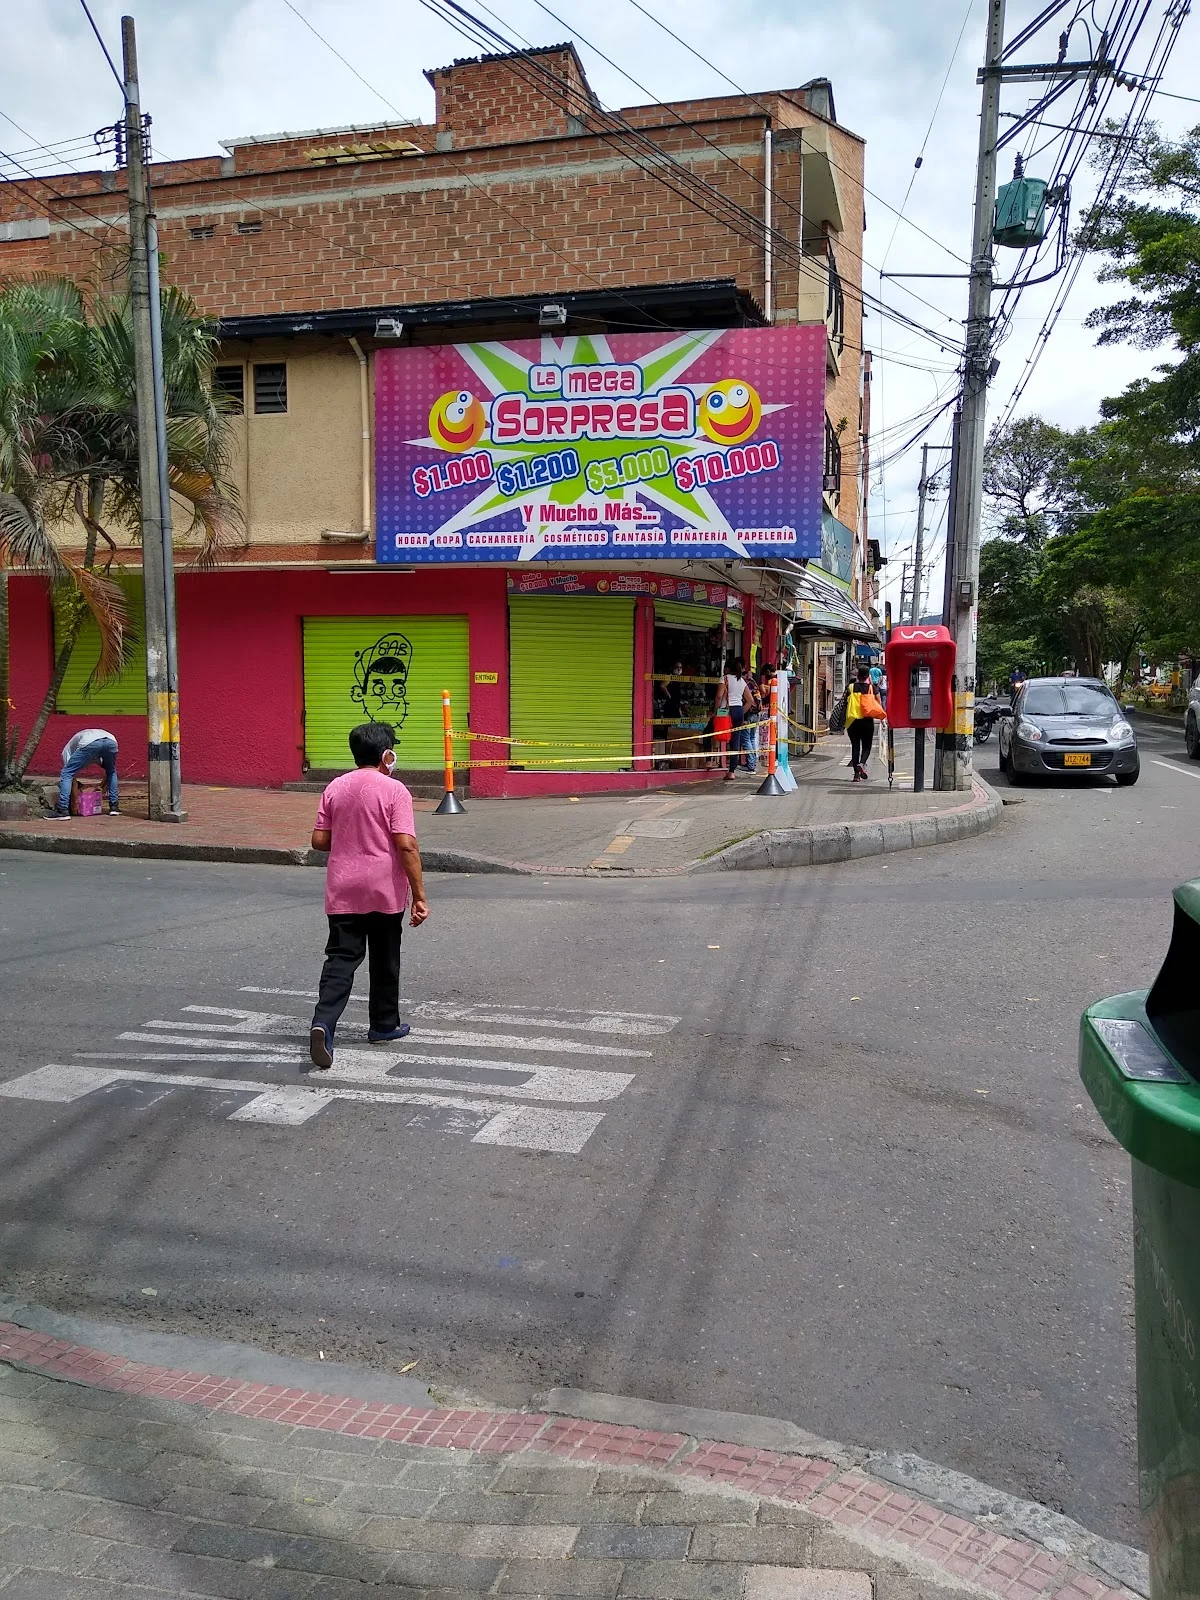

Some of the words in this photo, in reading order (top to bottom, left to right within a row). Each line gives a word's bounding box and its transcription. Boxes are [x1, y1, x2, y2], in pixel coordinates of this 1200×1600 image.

[414, 453, 492, 495] $1.000
[499, 452, 578, 493] $1.200
[587, 448, 669, 493] $5.000
[675, 443, 778, 491] $10.000
[523, 505, 534, 523] Y
[540, 504, 599, 523] Mucho
[604, 502, 657, 522] Más...
[398, 536, 428, 545] HOGAR
[436, 535, 461, 545] ROPA
[469, 532, 535, 544] CACHARRERÍA
[544, 532, 606, 543] COSMÉTICOS
[615, 530, 664, 542] FANTASÍA
[673, 529, 728, 541] PIÑATERÍA
[737, 528, 794, 541] PAPELERÍA
[900, 629, 939, 640] une
